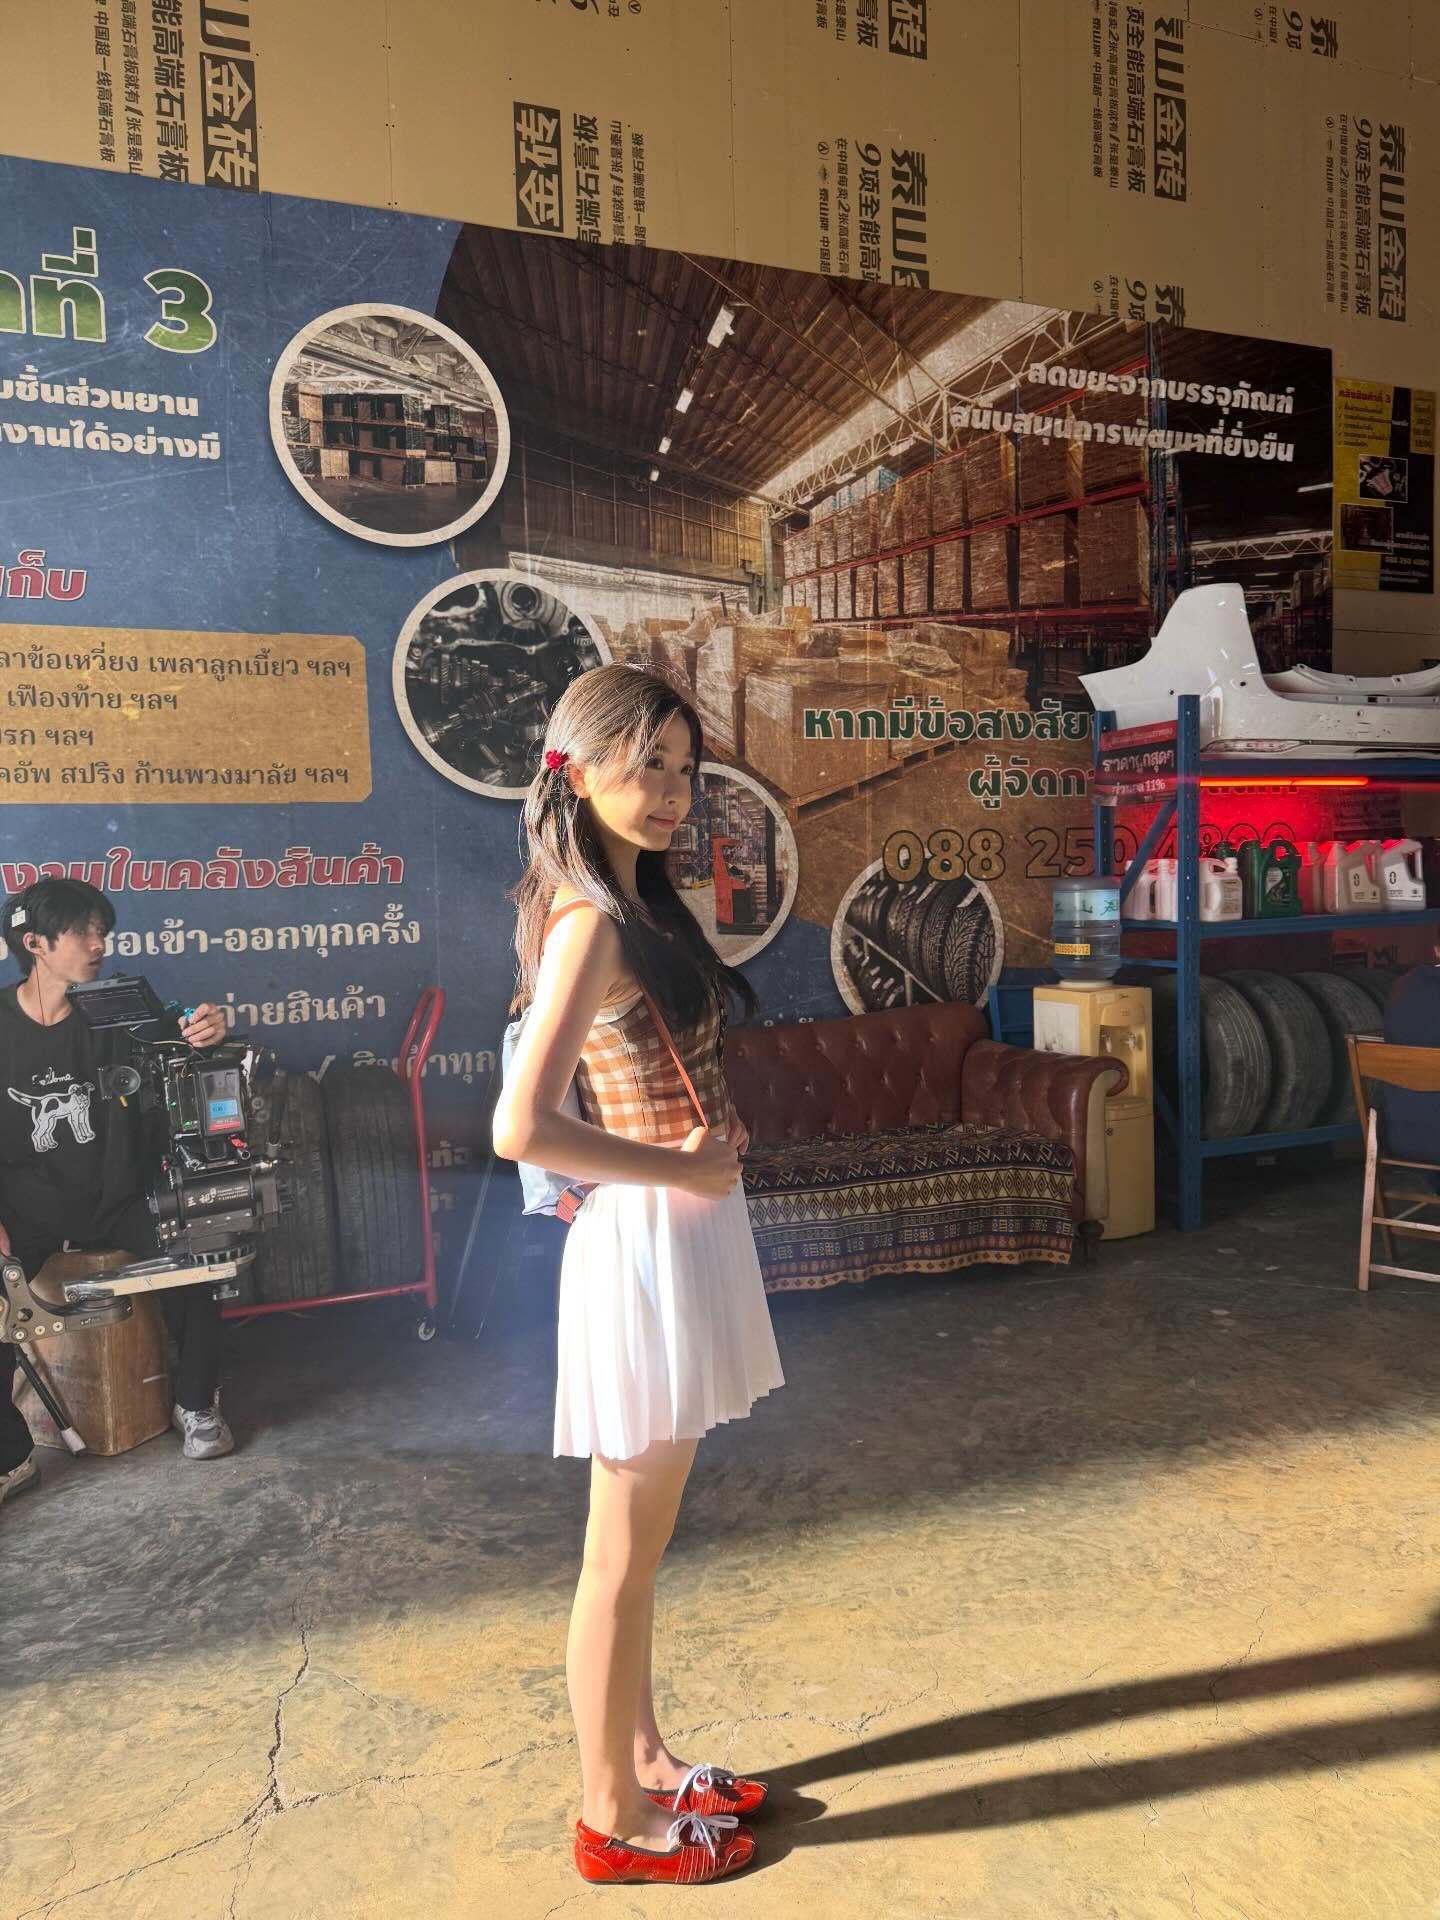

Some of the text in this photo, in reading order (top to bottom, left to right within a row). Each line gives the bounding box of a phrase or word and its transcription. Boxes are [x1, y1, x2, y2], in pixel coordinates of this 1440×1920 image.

[513, 103, 562, 232] 金砖
[143, 268, 218, 354] 3
[149, 647, 299, 682] เพลาลูกเบี้ยว
[307, 659, 351, 678] ฯลฯ
[8, 683, 178, 710] เฟืองท้าย ฯลฯ
[0, 728, 94, 747] รก ฯลฯ
[61, 760, 125, 785] สปริง
[304, 767, 349, 784] ฯลฯ
[882, 829, 1007, 883] 088
